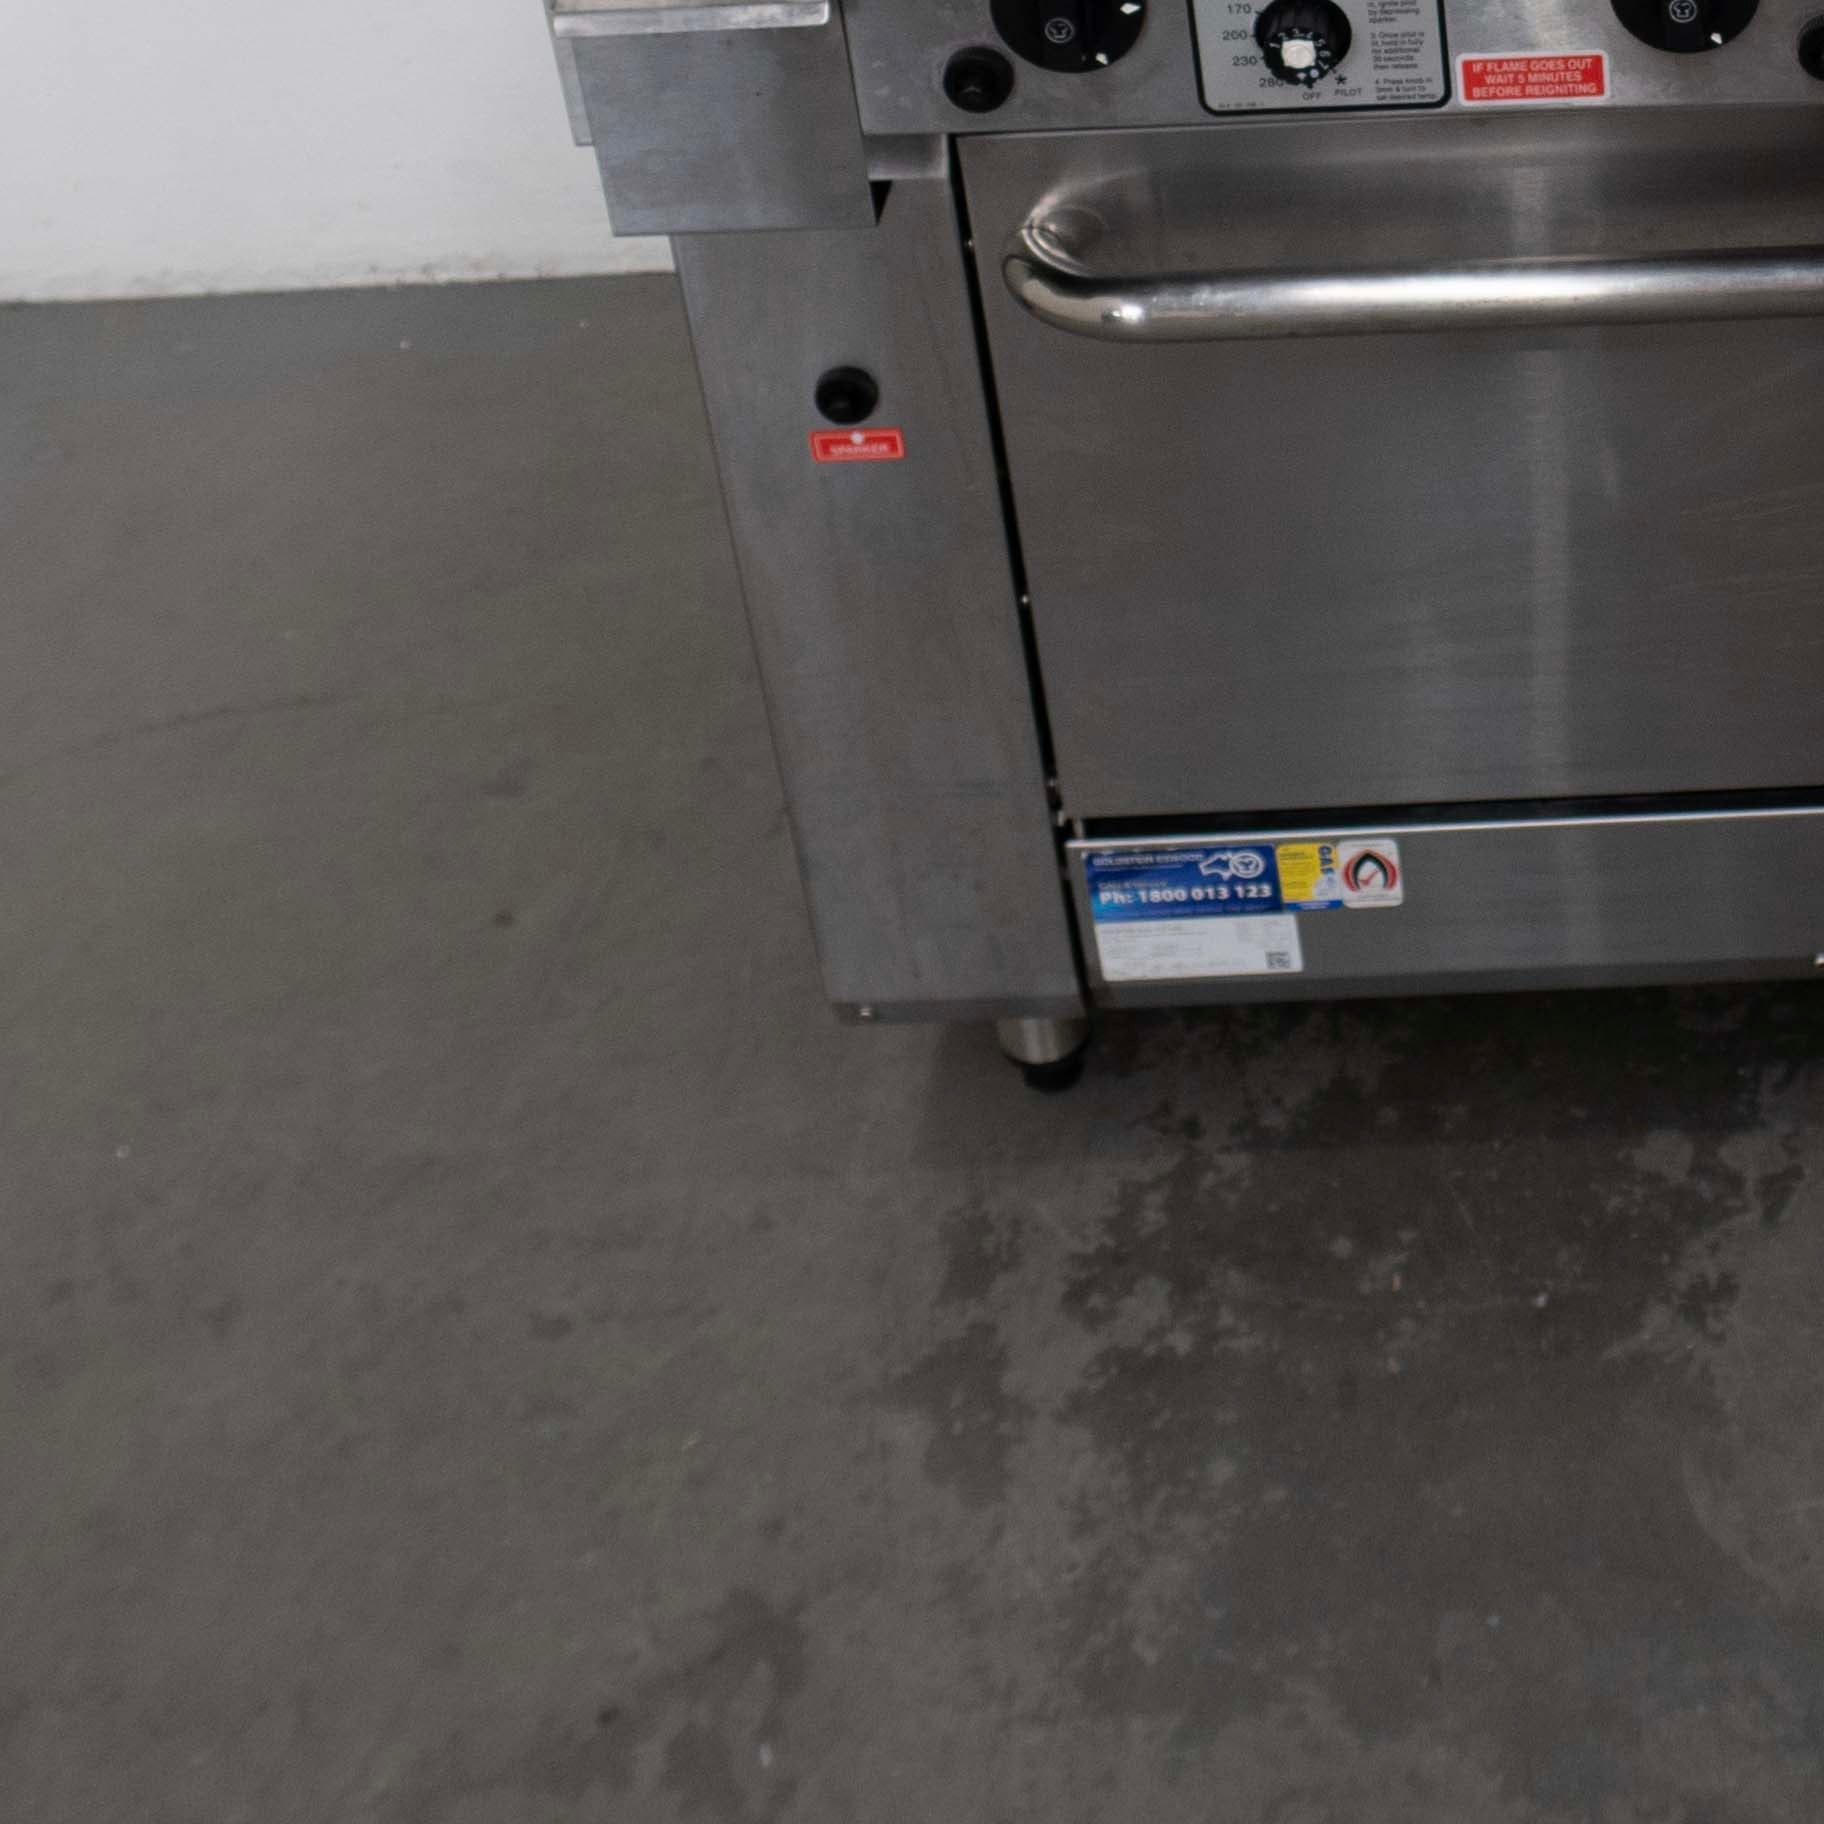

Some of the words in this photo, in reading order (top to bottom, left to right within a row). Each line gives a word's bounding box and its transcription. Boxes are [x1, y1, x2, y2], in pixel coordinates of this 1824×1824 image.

[1228, 3, 1252, 14] 170
[1232, 56, 1258, 66] 230
[1472, 63, 1482, 73] IF
[1486, 61, 1528, 72] FLAME
[1530, 59, 1564, 71] GOES
[1567, 58, 1593, 70] OUT
[1484, 74, 1515, 85] WAIT
[1528, 71, 1582, 83] MINUTES
[1302, 91, 1322, 101] OFF
[1335, 88, 1362, 97] PILOT
[1472, 86, 1521, 97] BEFORE
[1525, 83, 1596, 96] REIGNITING
[1100, 890, 1134, 905] Ph:
[1139, 888, 1187, 903] 1800
[1191, 886, 1231, 901] 013
[1235, 884, 1273, 899] 123
